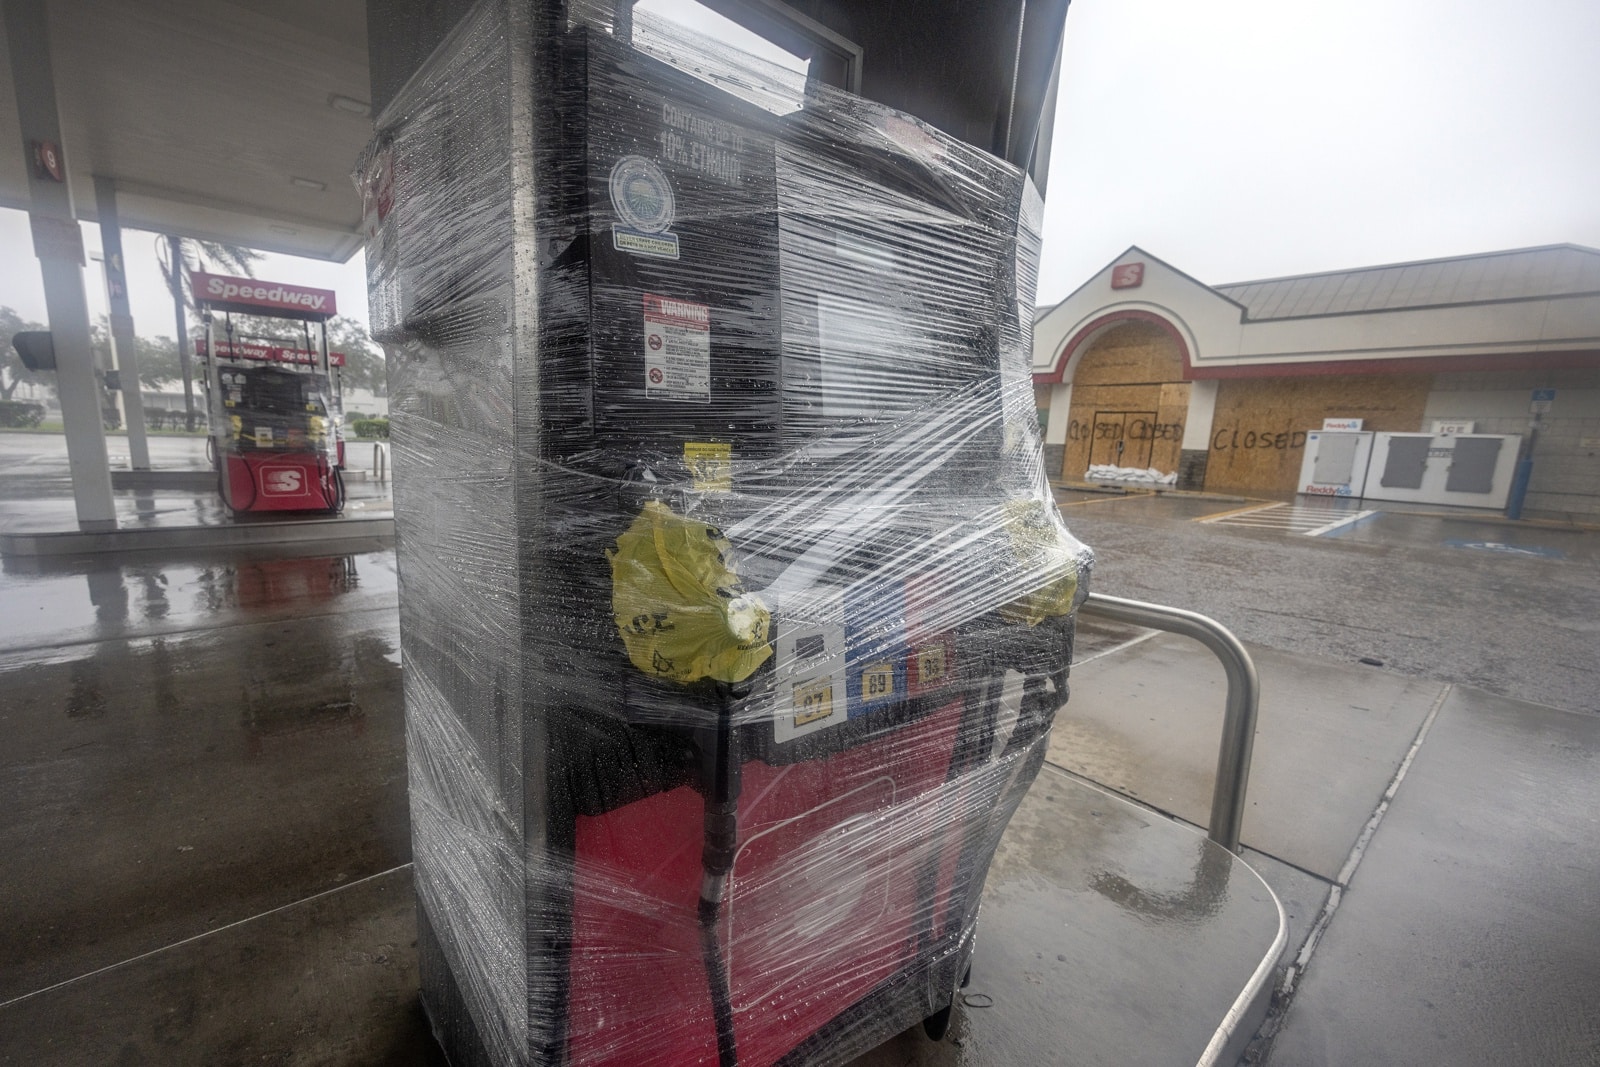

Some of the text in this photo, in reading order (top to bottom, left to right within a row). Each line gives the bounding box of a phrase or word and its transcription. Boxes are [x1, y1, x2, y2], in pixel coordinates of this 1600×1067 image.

[1119, 264, 1141, 286] S
[207, 278, 325, 309] Speedway
[660, 299, 708, 322] WARNING
[1440, 426, 1465, 434] ICE
[1306, 484, 1353, 496] ReddyIce
[868, 674, 887, 695] 89
